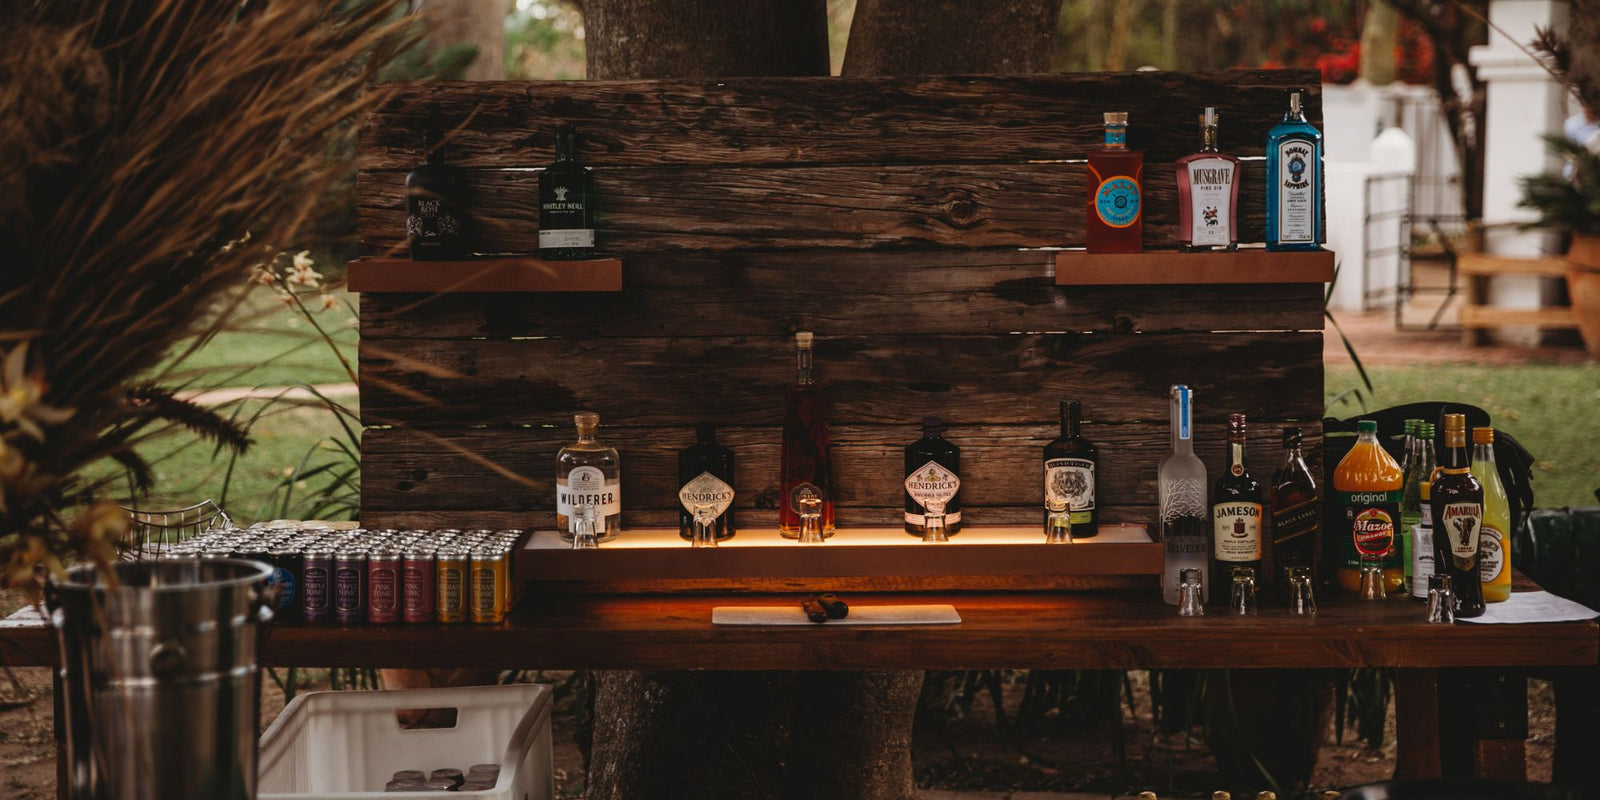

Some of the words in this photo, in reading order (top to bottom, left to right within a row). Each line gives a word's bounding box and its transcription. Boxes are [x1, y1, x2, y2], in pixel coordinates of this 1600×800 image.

[1285, 147, 1309, 157] BOMBAY
[1193, 168, 1230, 185] MUSGRAVE
[1284, 179, 1310, 189] SAPPHIRE
[908, 480, 958, 491] HENDRICK'S
[561, 492, 614, 506] WILDERER
[1350, 491, 1387, 505] original
[1216, 506, 1261, 519] JAMESON
[1444, 504, 1481, 520] AMARULA
[1354, 519, 1393, 532] Mazoe
[1361, 531, 1386, 540] ORANGE
